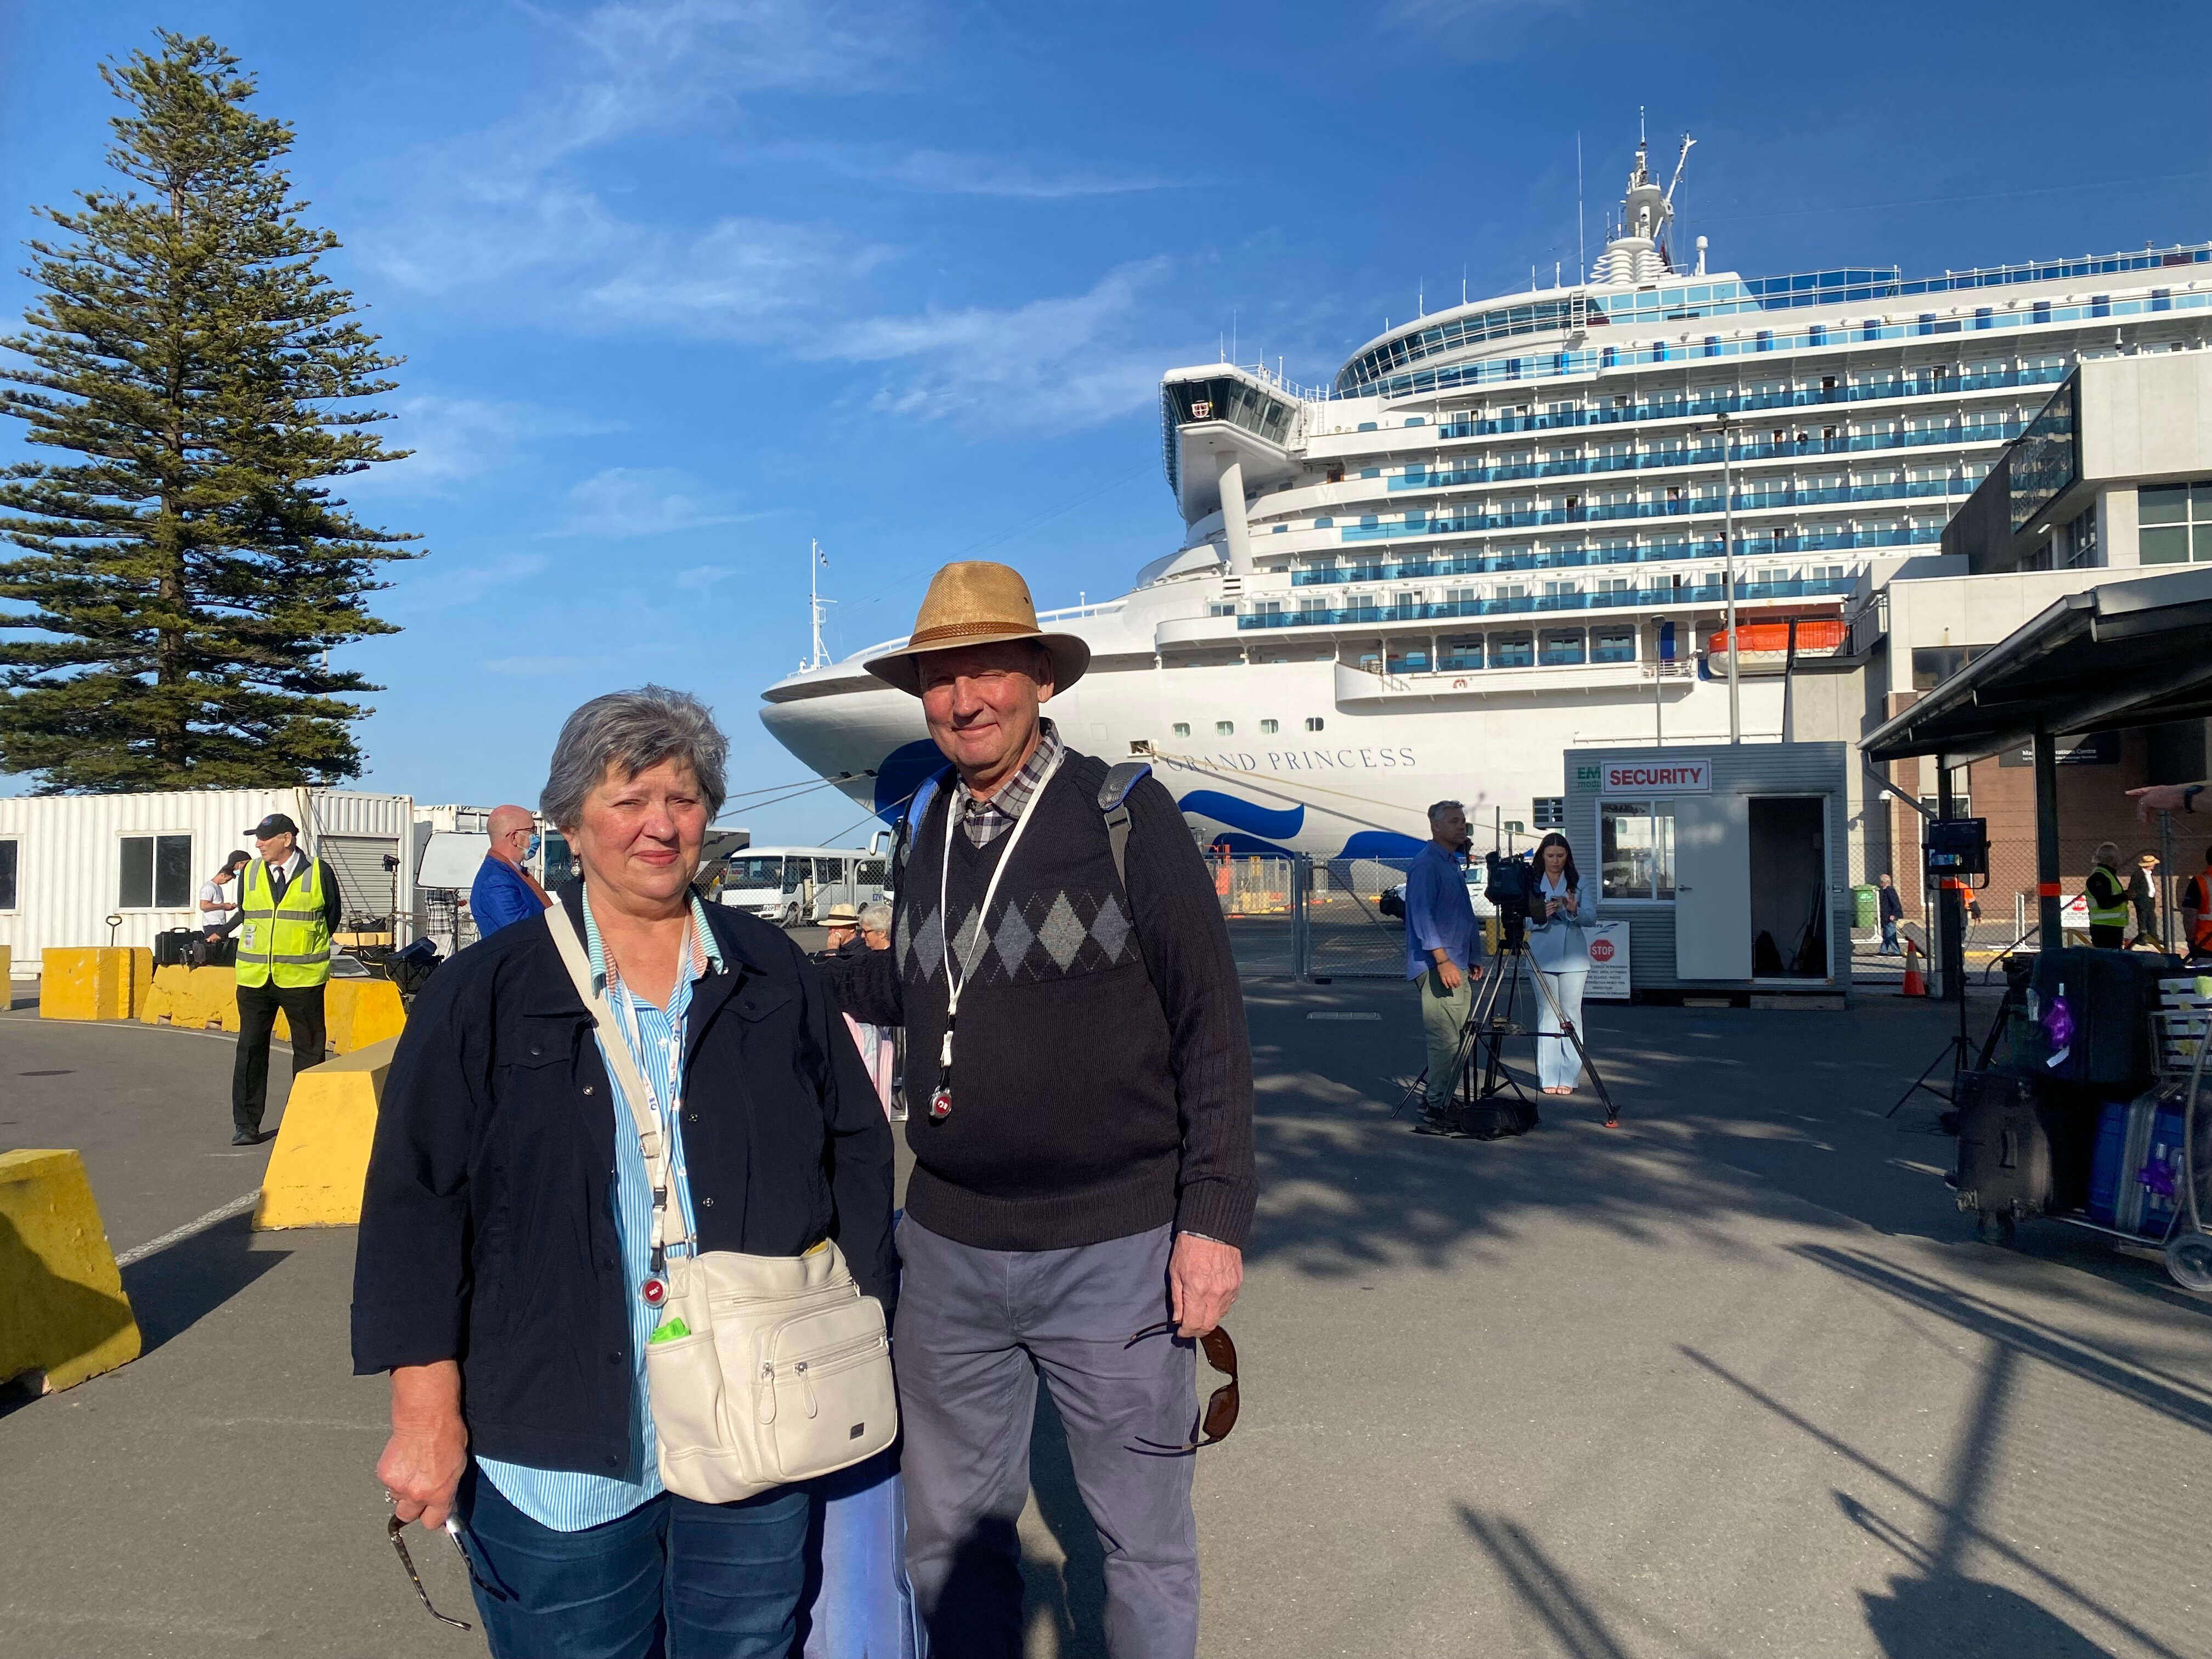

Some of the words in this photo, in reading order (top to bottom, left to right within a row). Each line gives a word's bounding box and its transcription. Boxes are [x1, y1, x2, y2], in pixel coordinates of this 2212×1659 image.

[1166, 752, 1256, 772] GRAND
[1267, 747, 1416, 771] PRINCESS
[1610, 768, 1702, 786] SECURITY
[1578, 780, 1601, 788] modu
[1592, 946, 1613, 955] STOP
